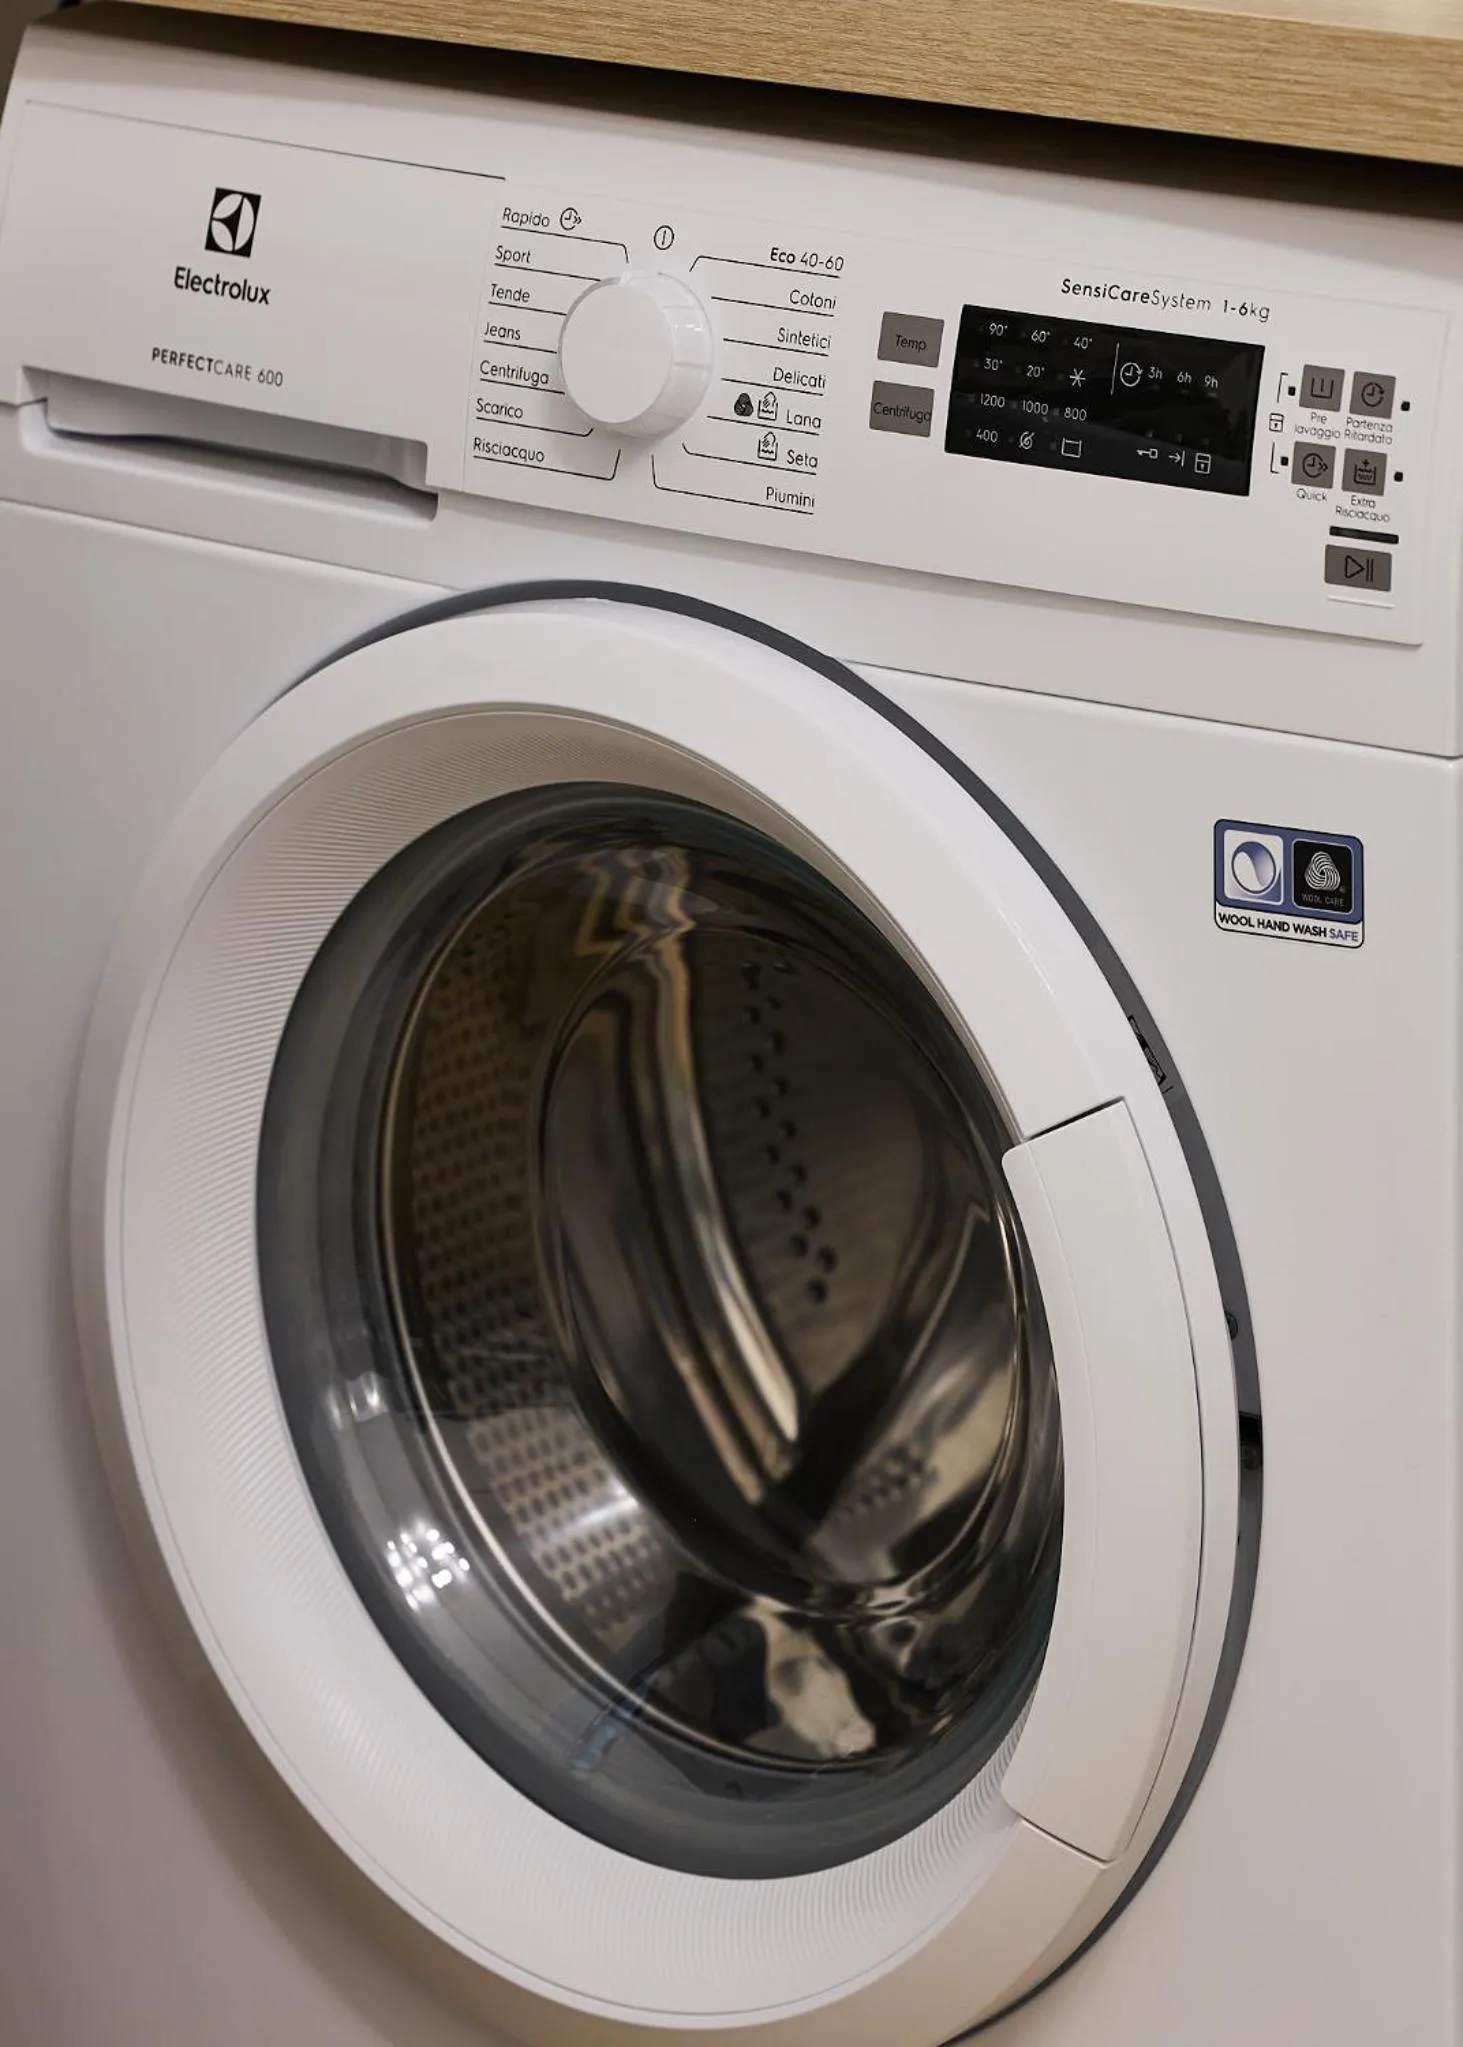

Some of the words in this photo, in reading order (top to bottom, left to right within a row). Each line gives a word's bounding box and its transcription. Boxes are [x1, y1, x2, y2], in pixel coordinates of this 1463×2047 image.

[502, 207, 551, 228] Rapido
[495, 245, 531, 263] Sport
[770, 247, 796, 264] Eco
[800, 252, 844, 272] 40-60
[174, 266, 271, 305] Electrolux
[491, 283, 531, 303] Tende
[789, 289, 837, 310] Cotoni
[1060, 278, 1212, 312] SensiCareSystem
[1222, 299, 1271, 323] 1-6kg
[484, 322, 521, 341] Jeans
[777, 327, 832, 350] Sintetici
[152, 347, 252, 382] PERFECTCARE
[257, 368, 283, 387] 600
[479, 360, 550, 387] Centrifuga
[1147, 366, 1164, 380] 3h
[1176, 371, 1193, 385] 6h
[1203, 375, 1220, 389] 9h
[773, 367, 827, 389] Delicati
[476, 397, 524, 419] Scarico
[980, 393, 1006, 409] 1200
[1022, 400, 1049, 415] 1000
[1064, 407, 1088, 422] 800
[1310, 411, 1328, 424] Pre
[786, 409, 822, 429] Lana
[1346, 416, 1393, 433] Partenza
[976, 429, 999, 444] 400
[1295, 424, 1341, 440] lavaggio
[473, 437, 546, 463] Risciacquo
[786, 450, 819, 469] Seta
[766, 486, 816, 508] Piumini
[1296, 488, 1328, 502] Quick
[1350, 495, 1376, 509] Extra
[1335, 505, 1391, 523] Risciacquo
[1218, 912, 1255, 928] WOOL
[1257, 918, 1290, 932] HAND
[1293, 923, 1327, 938] WASH
[1329, 928, 1359, 942] SAFE
